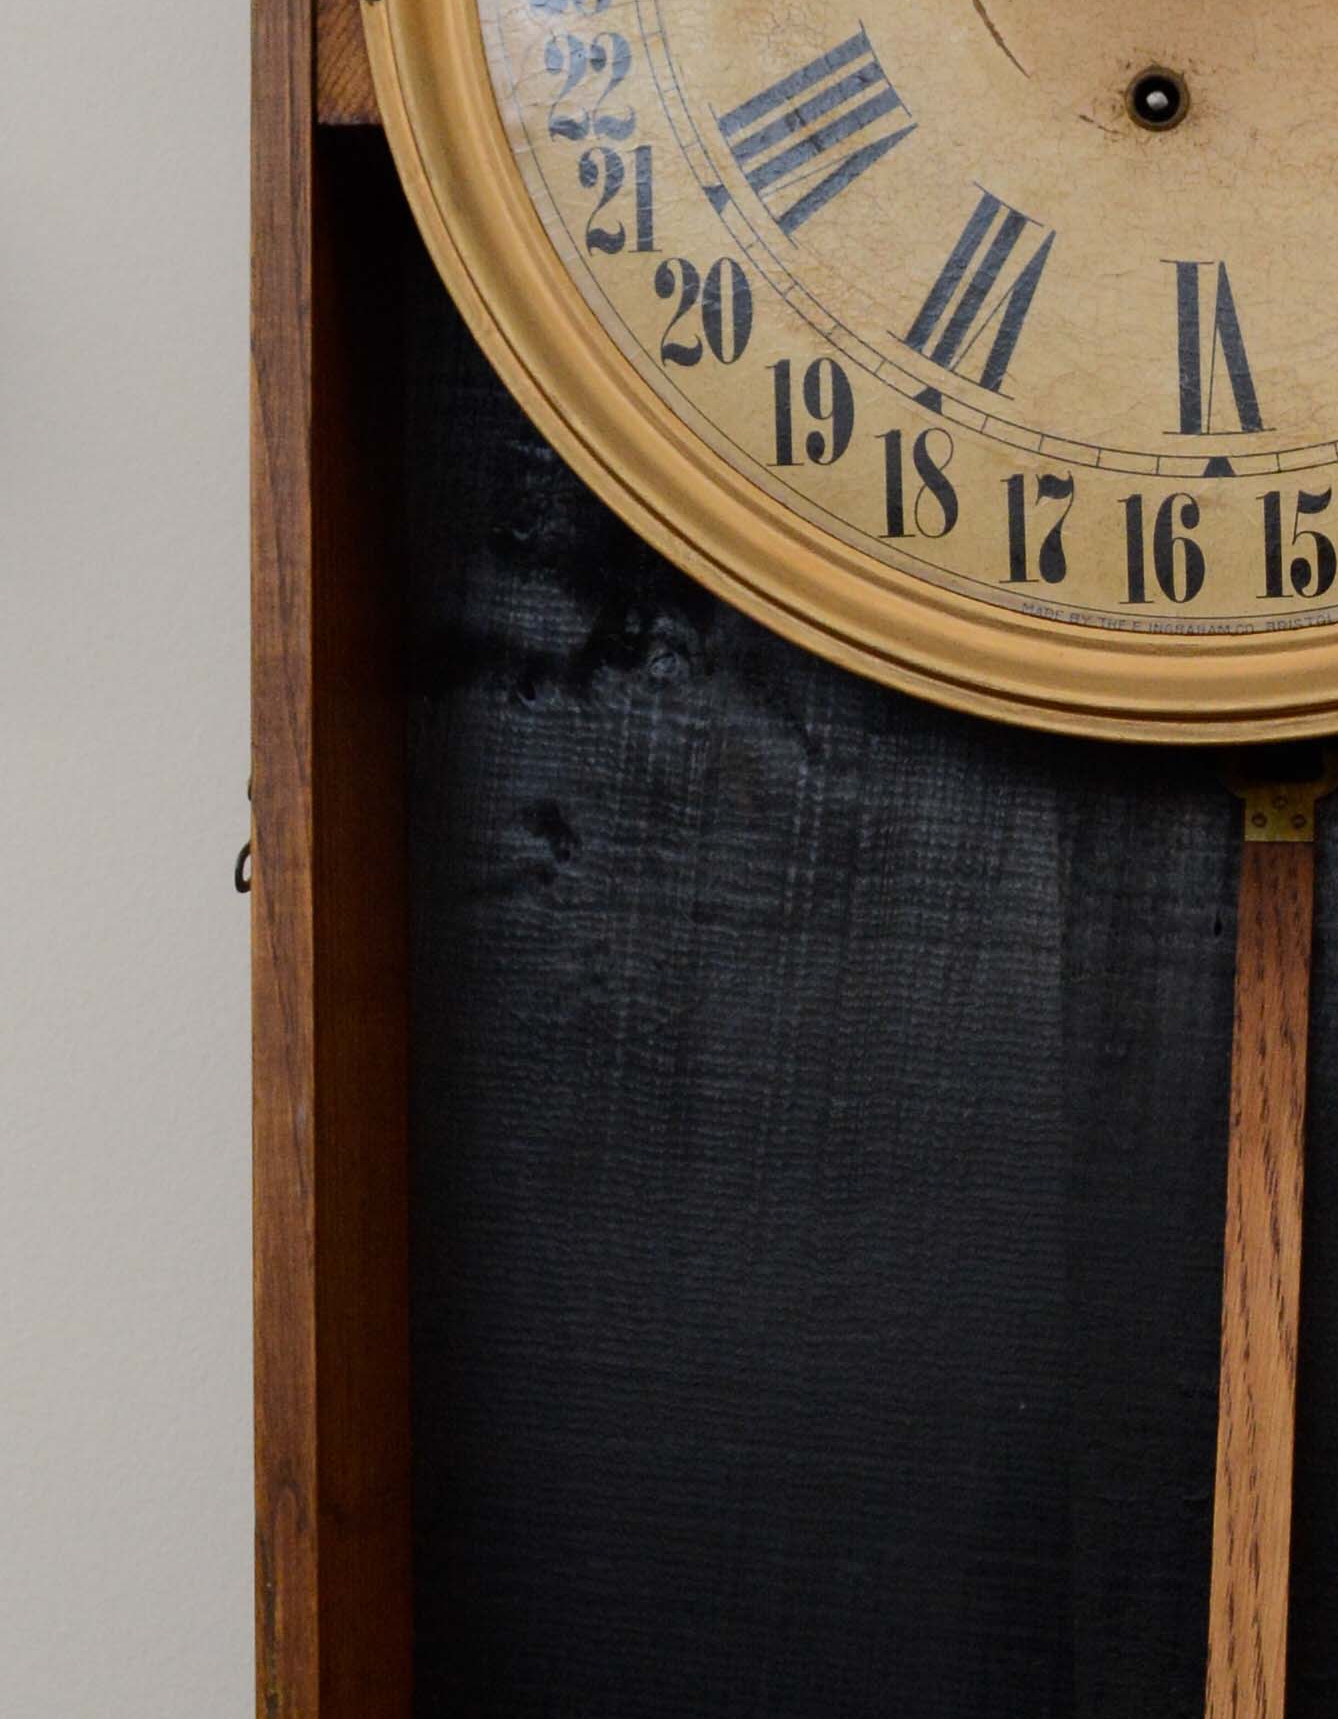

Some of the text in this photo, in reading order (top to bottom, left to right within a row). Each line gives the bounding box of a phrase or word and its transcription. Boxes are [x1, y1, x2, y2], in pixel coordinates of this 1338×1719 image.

[544, 32, 637, 141] 22
[578, 145, 663, 255] 21
[654, 257, 753, 367] 20
[766, 356, 855, 468] 19
[875, 427, 959, 539] 18
[999, 471, 1075, 583] 17
[1117, 492, 1206, 604] 16
[1254, 486, 1338, 599] 15
